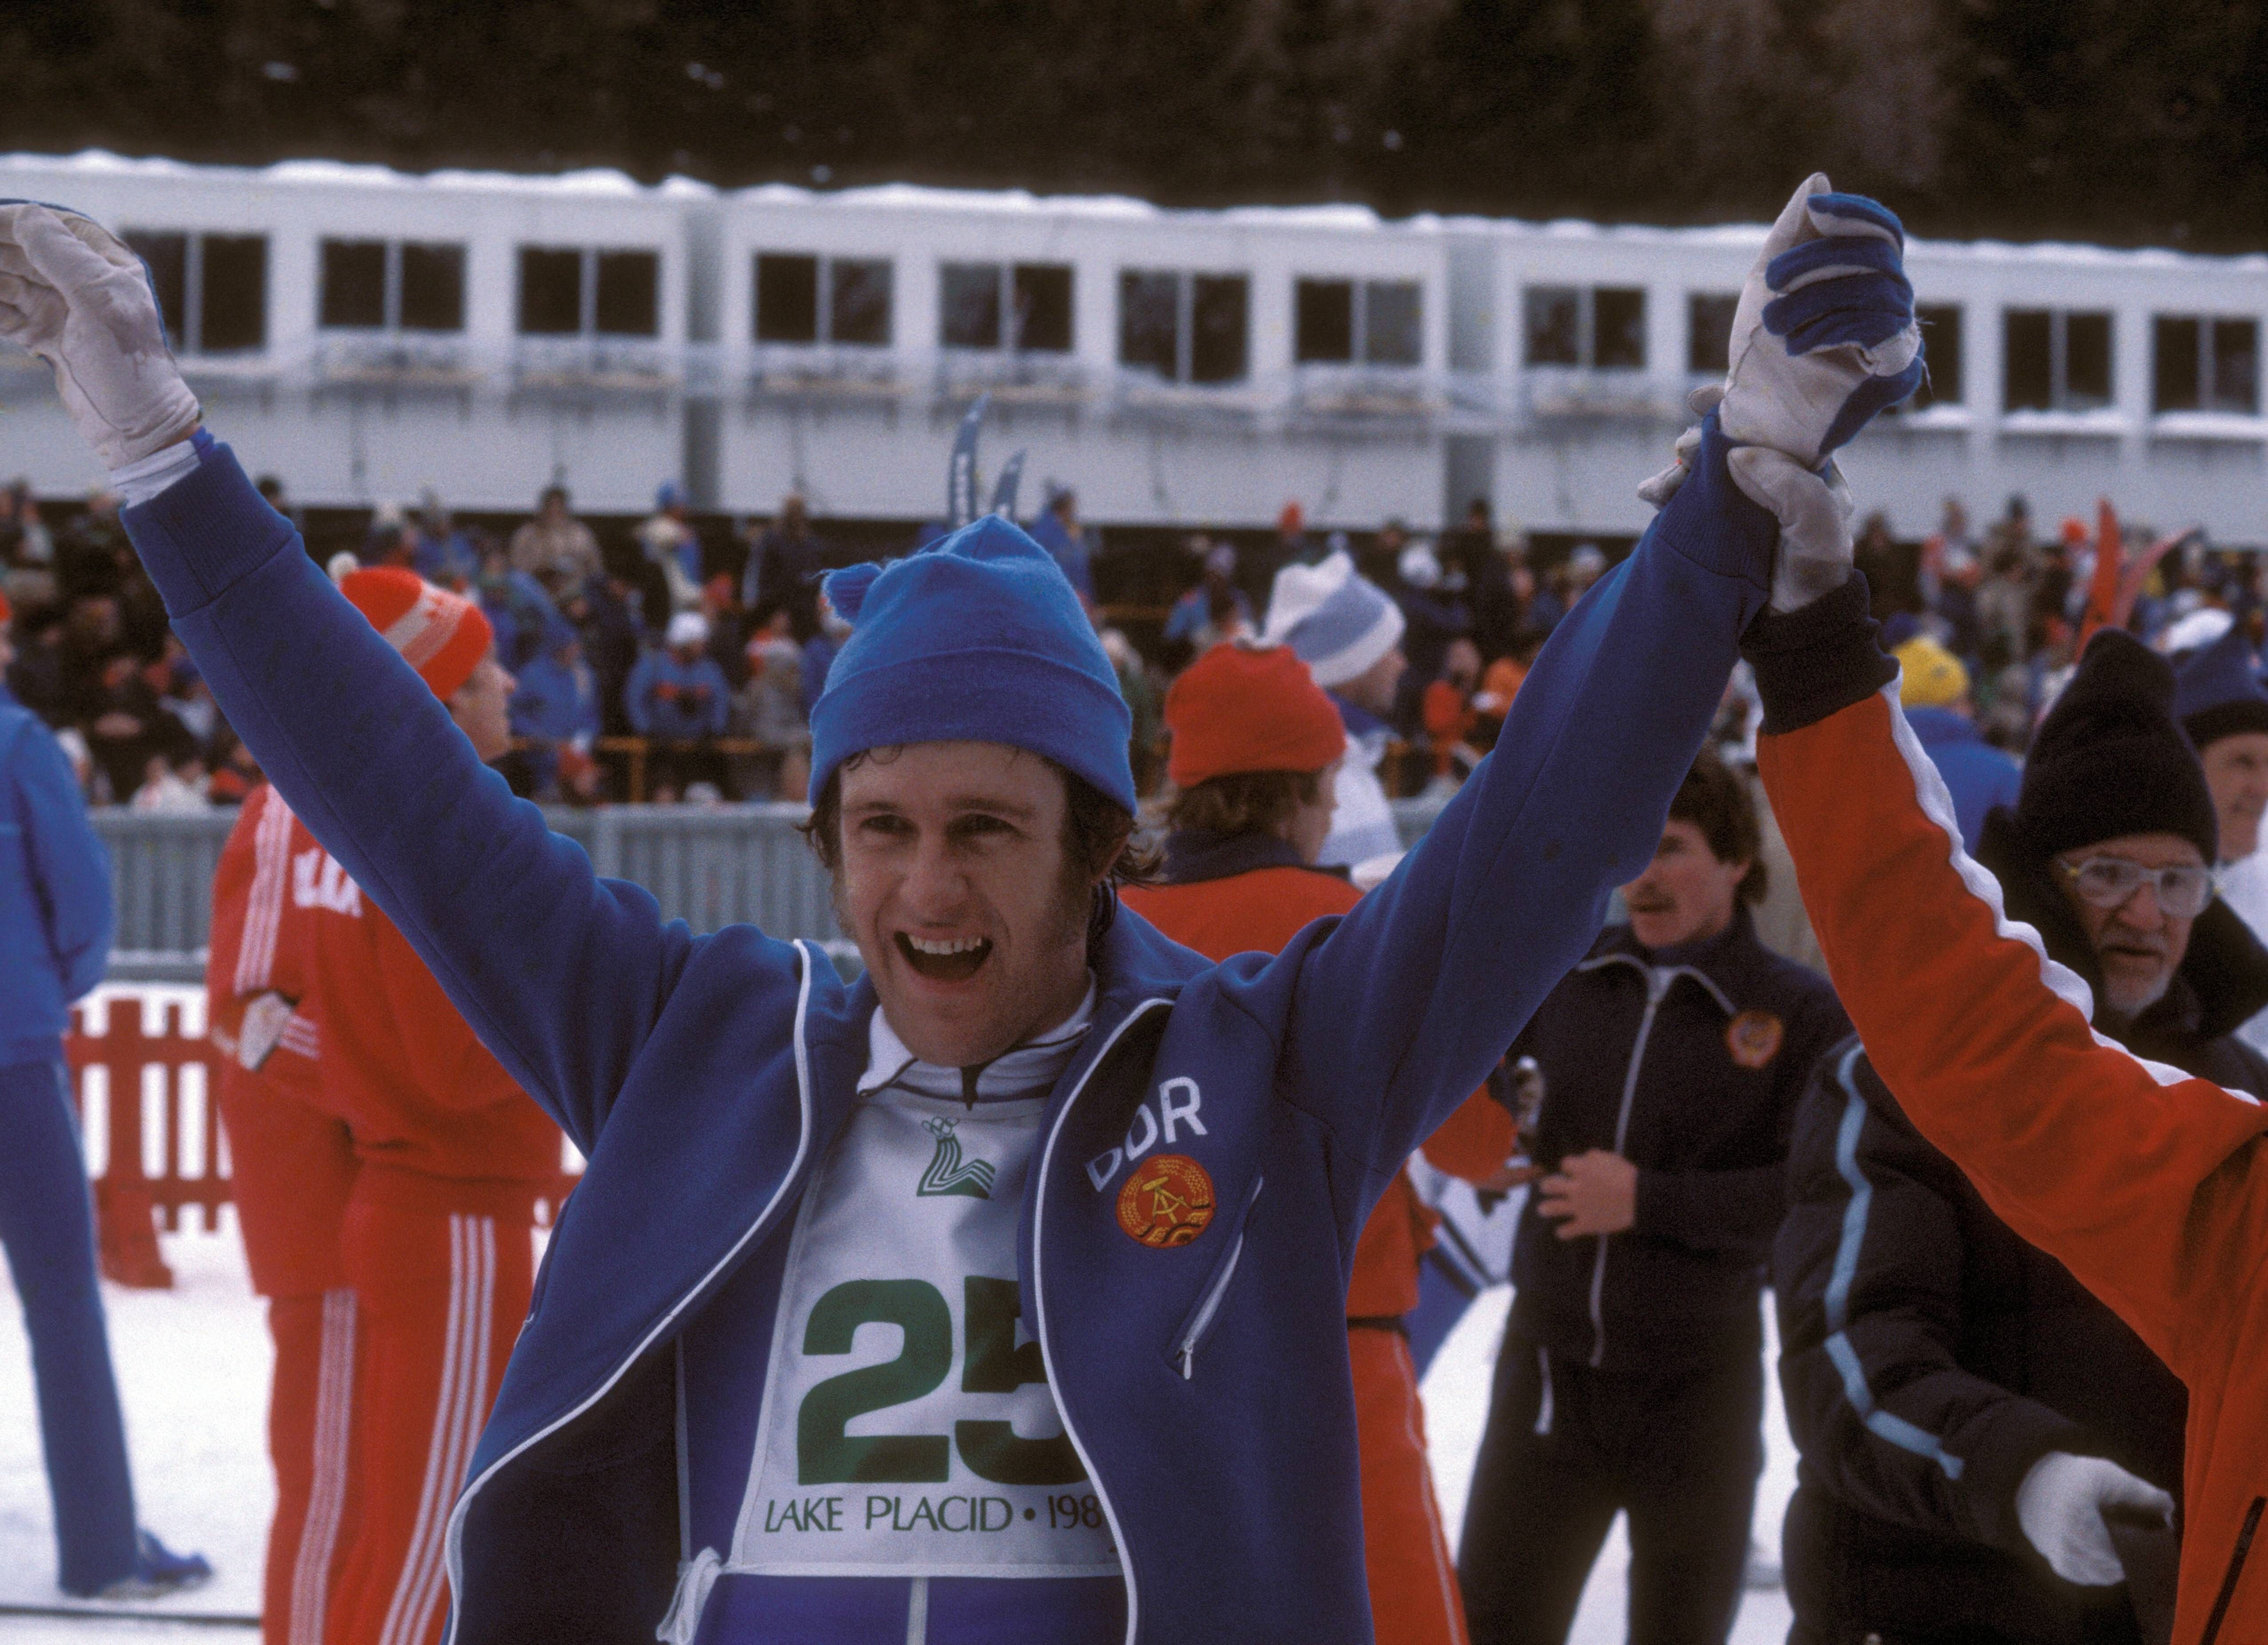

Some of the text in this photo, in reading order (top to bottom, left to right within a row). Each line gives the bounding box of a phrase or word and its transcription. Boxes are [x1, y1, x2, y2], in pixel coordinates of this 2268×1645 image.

[1085, 1076, 1207, 1192] DDR
[797, 1275, 1089, 1485] 25
[764, 1494, 1103, 1533] LAKE PLACID 198
